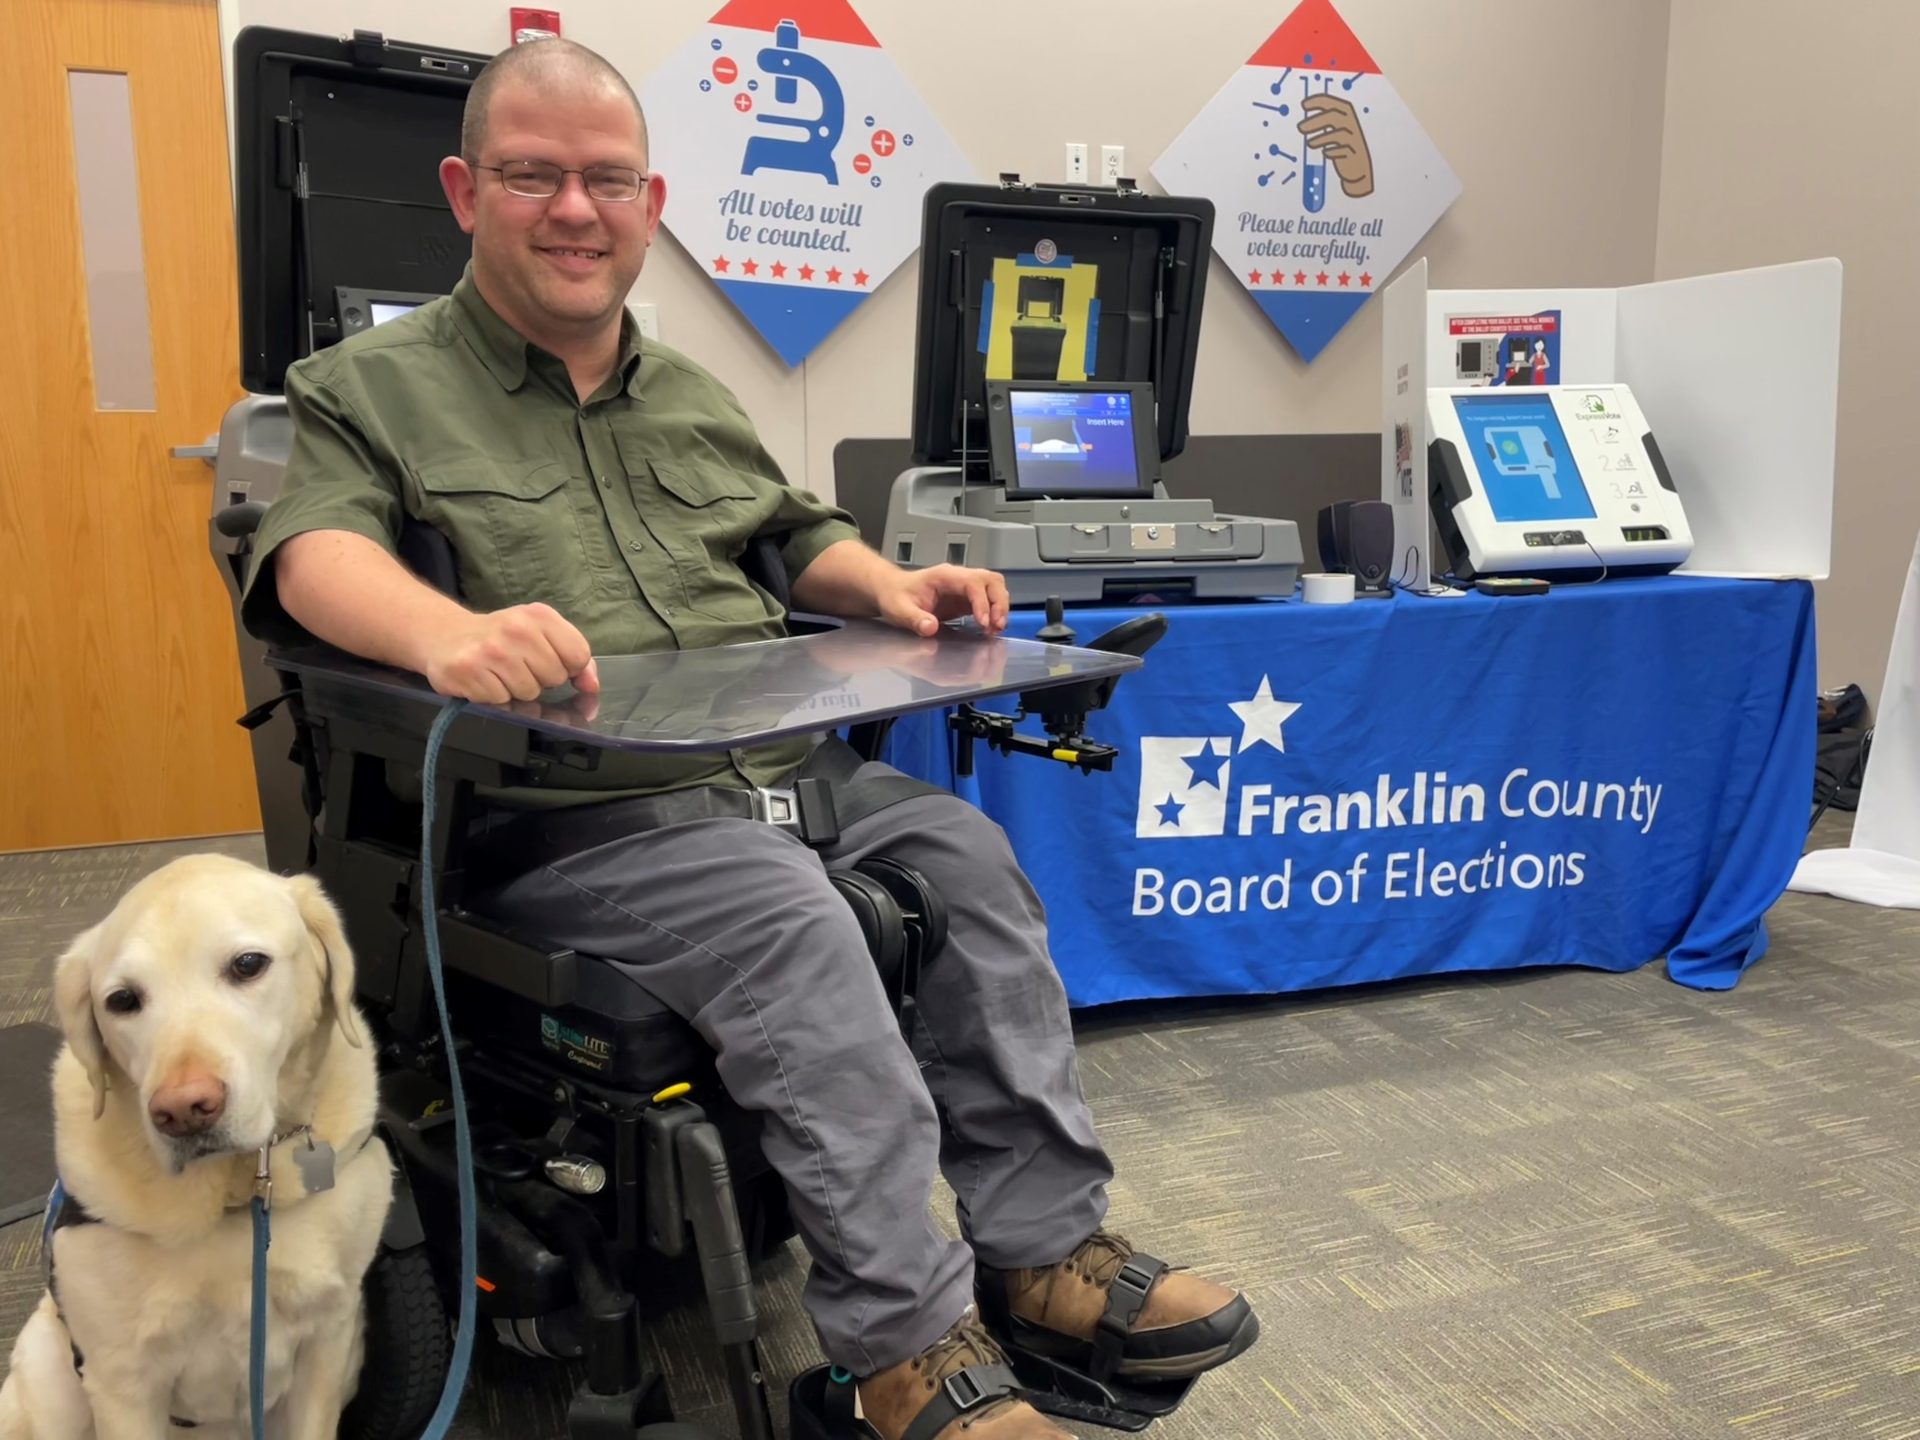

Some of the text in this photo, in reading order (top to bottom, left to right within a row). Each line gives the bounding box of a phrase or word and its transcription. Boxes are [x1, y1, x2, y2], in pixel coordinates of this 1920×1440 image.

[718, 189, 863, 227] All votes will
[1238, 211, 1383, 237] Please handle all
[726, 218, 851, 253] be counted.
[1247, 239, 1371, 266] votes carefully.
[1087, 418, 1107, 426] Insert
[1238, 767, 1663, 836] Franklin County
[1131, 841, 1586, 917] Board of Elections
